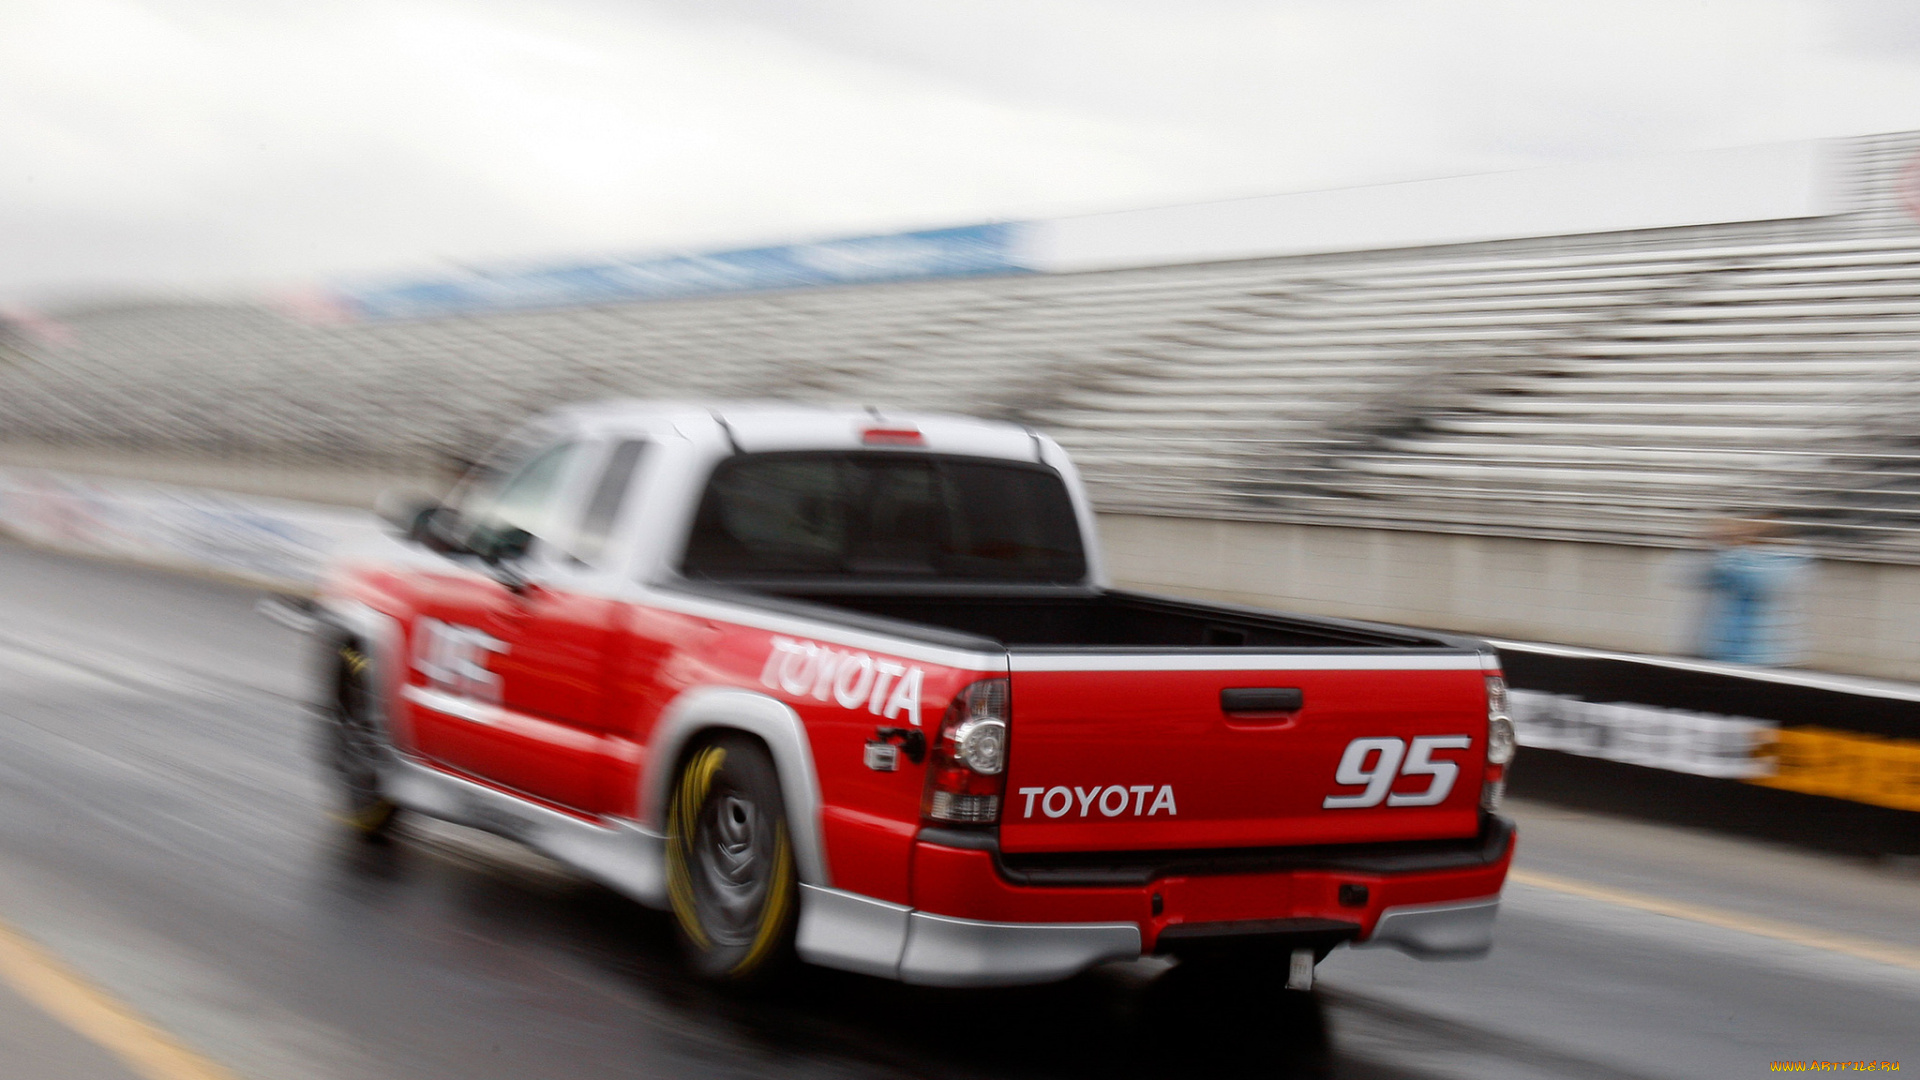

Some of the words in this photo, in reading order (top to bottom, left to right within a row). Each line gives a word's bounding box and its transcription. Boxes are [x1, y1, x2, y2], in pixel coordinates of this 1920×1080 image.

[760, 635, 925, 726] TOYOTA
[1018, 785, 1177, 818] TOYOTA
[1323, 735, 1472, 809] 95
